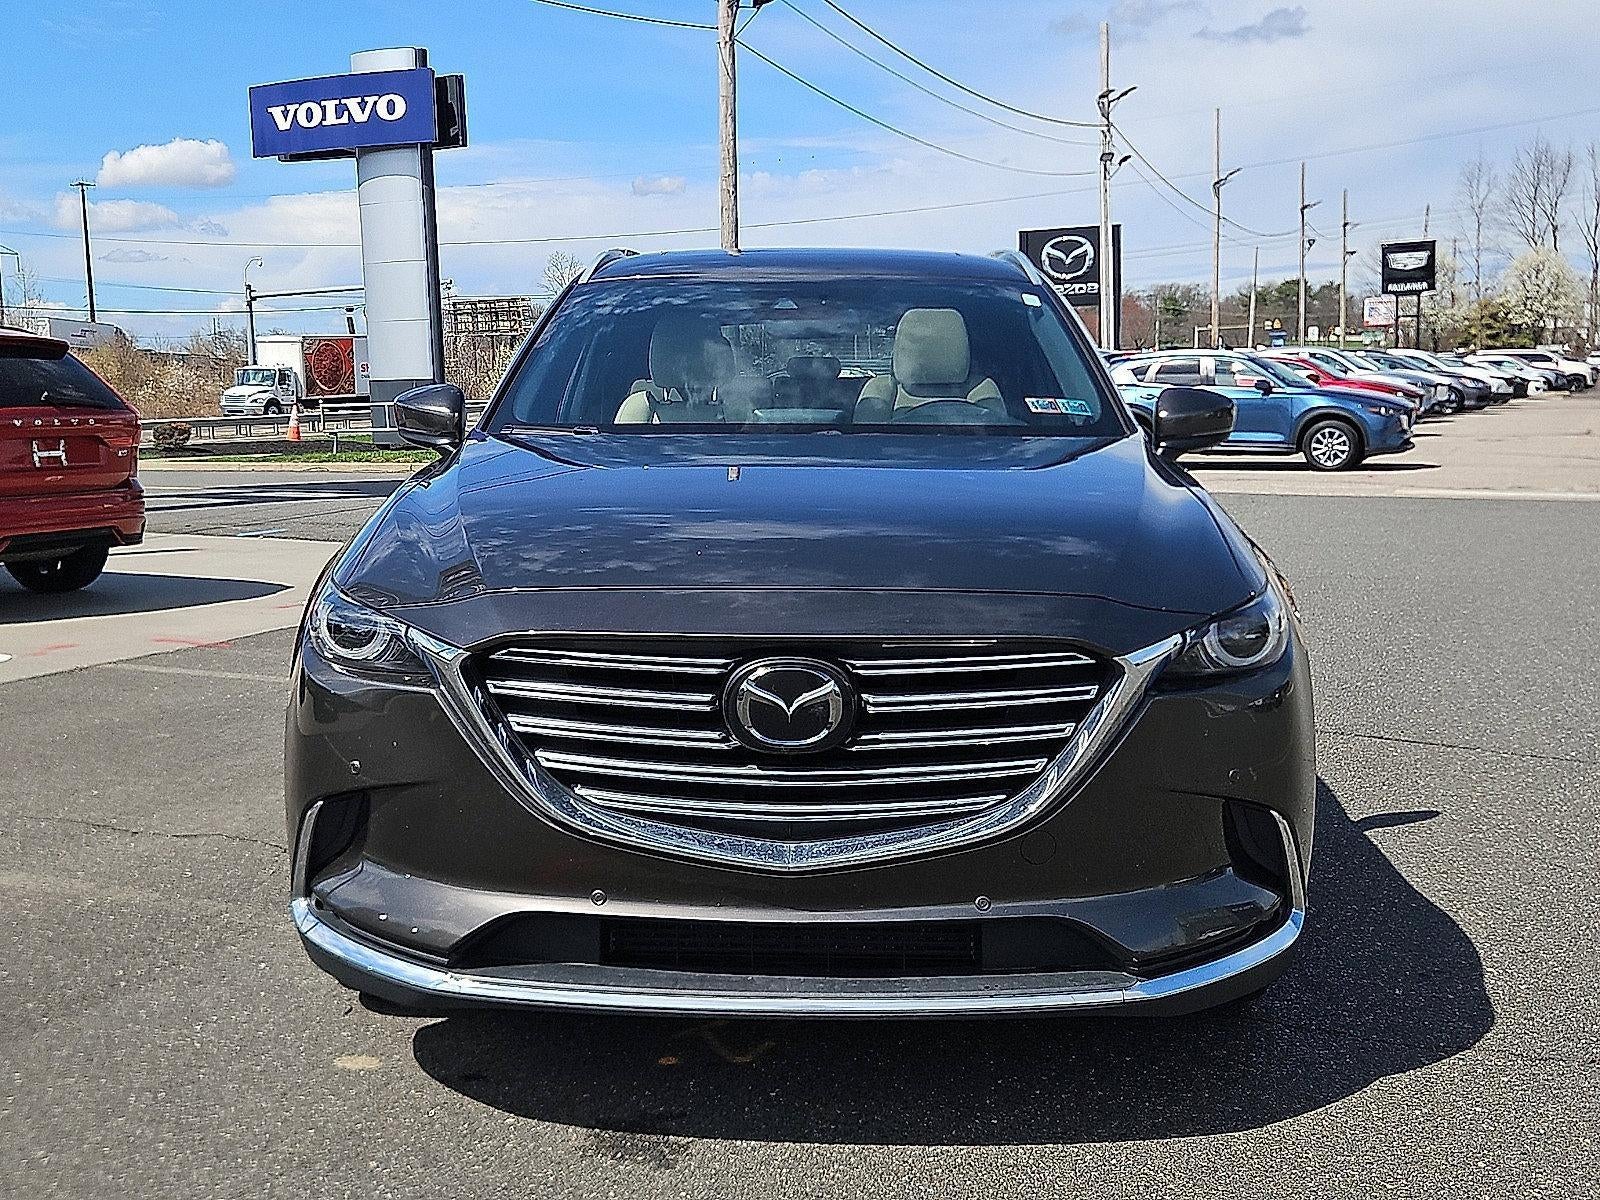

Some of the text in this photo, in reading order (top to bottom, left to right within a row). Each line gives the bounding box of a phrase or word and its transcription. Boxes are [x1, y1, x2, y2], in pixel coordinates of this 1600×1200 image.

[266, 92, 408, 131] VOLVO
[1053, 282, 1100, 295] azda
[12, 418, 95, 427] VOLVO
